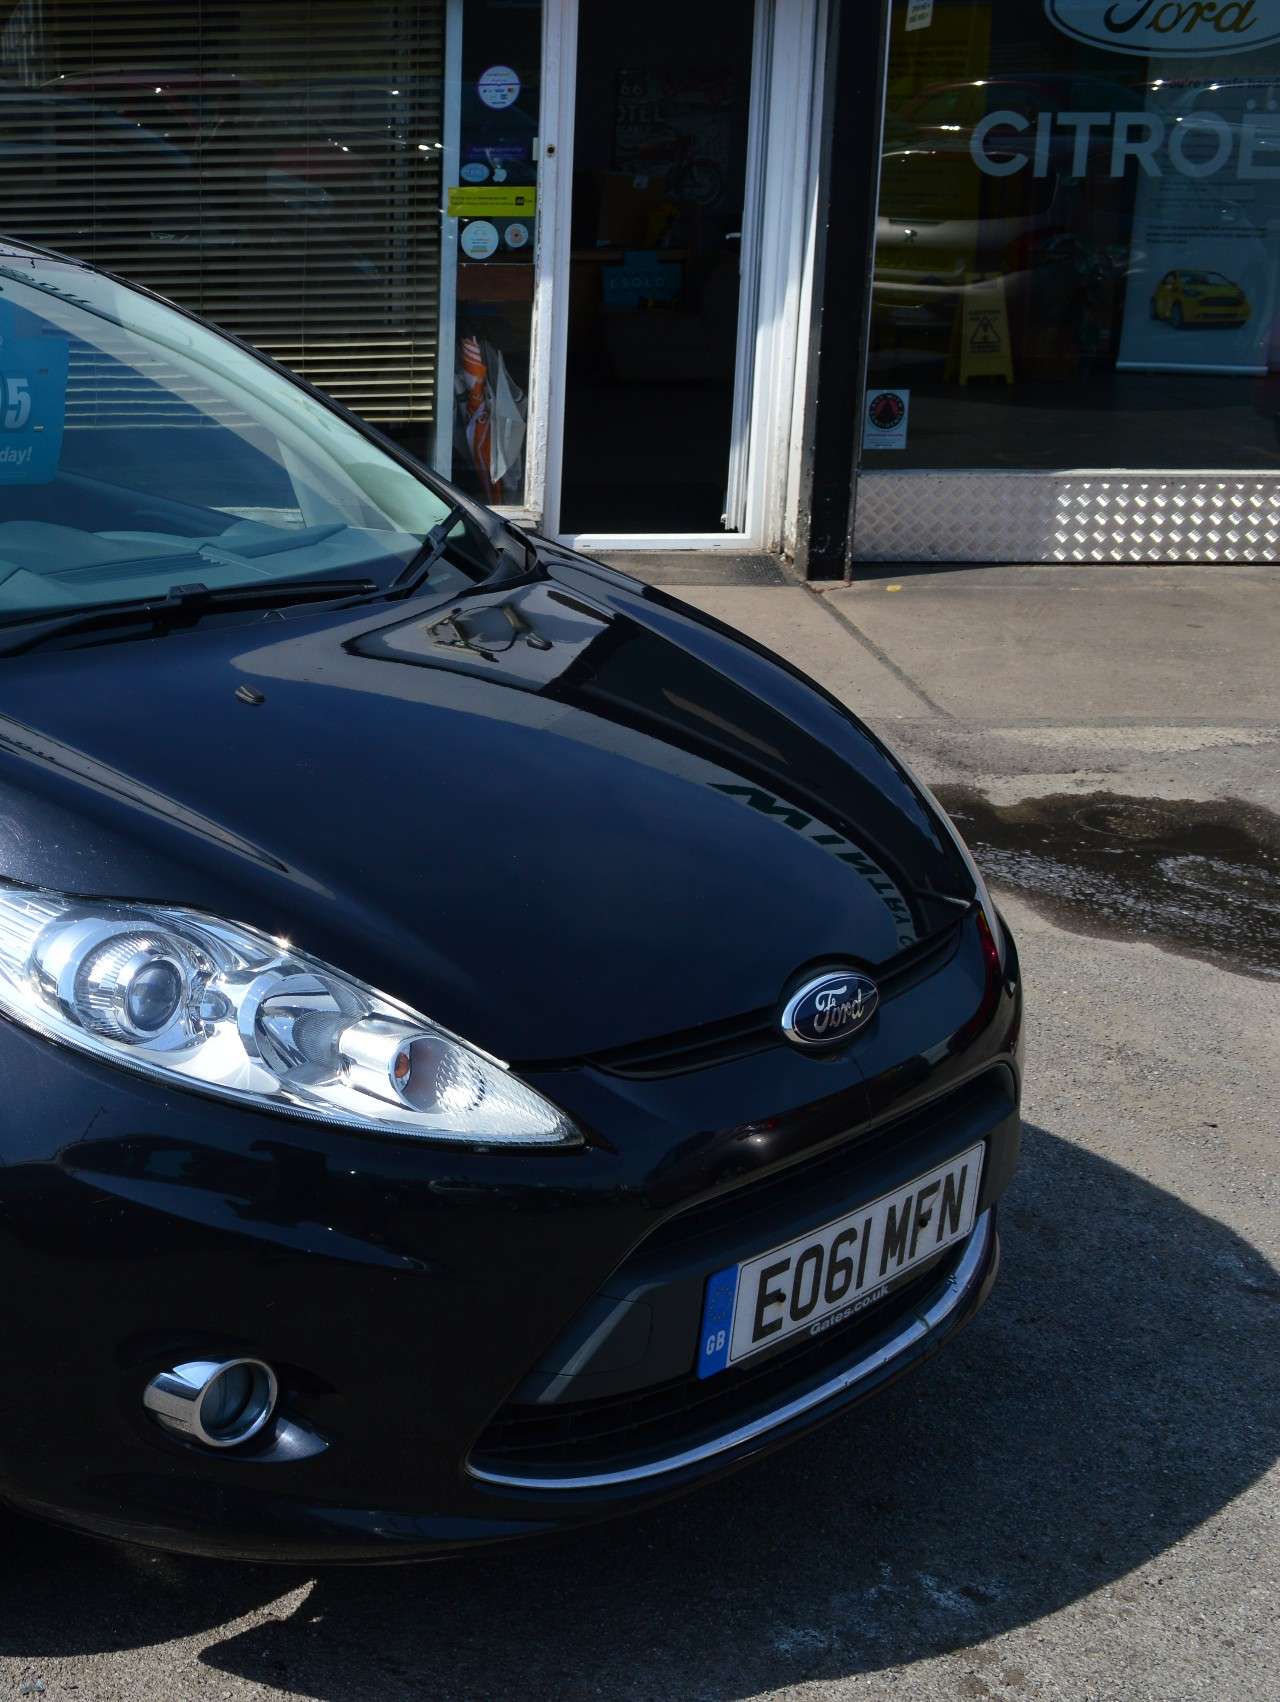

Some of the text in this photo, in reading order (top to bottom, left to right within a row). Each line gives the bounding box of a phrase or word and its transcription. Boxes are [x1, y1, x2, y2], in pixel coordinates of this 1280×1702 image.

[813, 985, 865, 1034] Ford
[751, 1164, 968, 1344] EO61 MFN
[706, 1330, 726, 1356] GB
